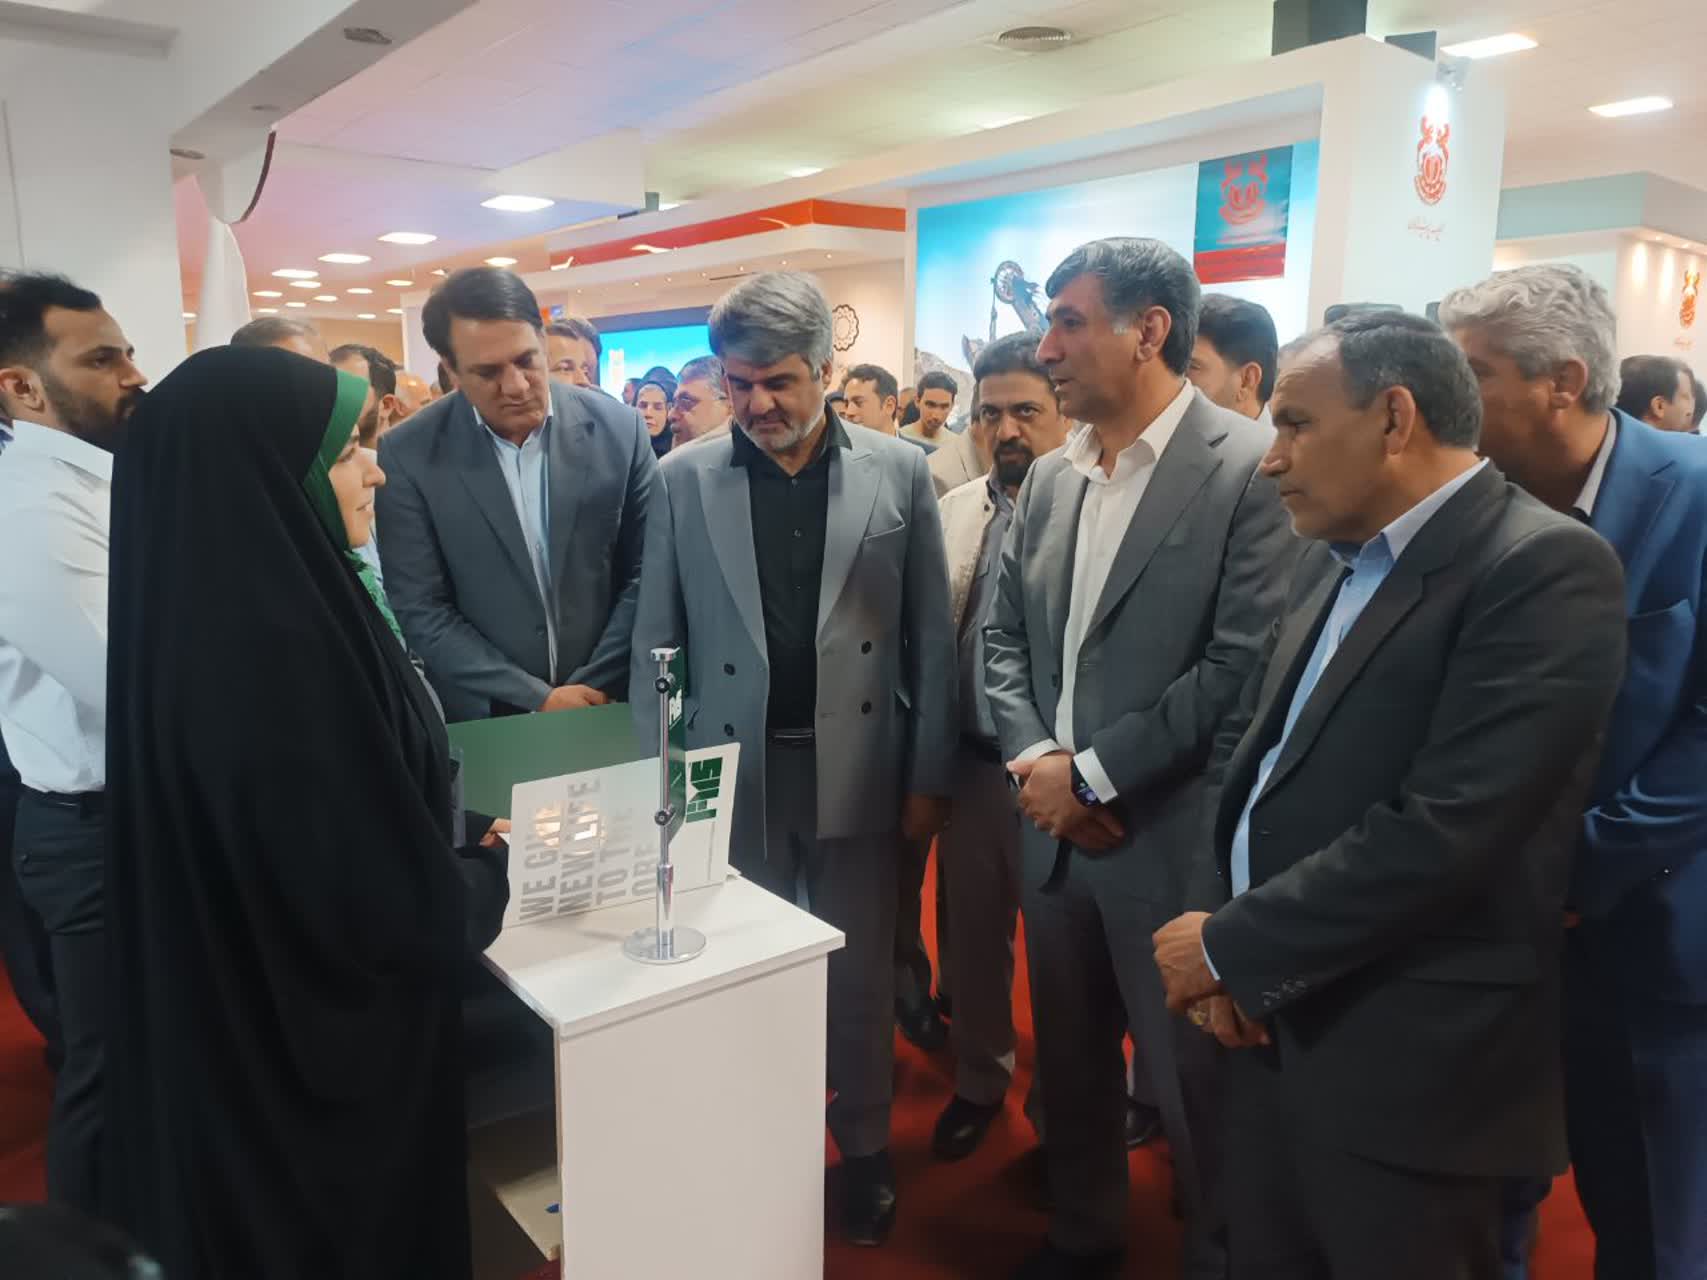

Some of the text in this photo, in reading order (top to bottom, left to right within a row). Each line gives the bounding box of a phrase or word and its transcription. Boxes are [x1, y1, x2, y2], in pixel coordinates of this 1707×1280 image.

[520, 876, 556, 919] WE
[558, 850, 594, 913] NEW
[596, 869, 629, 905] TO
